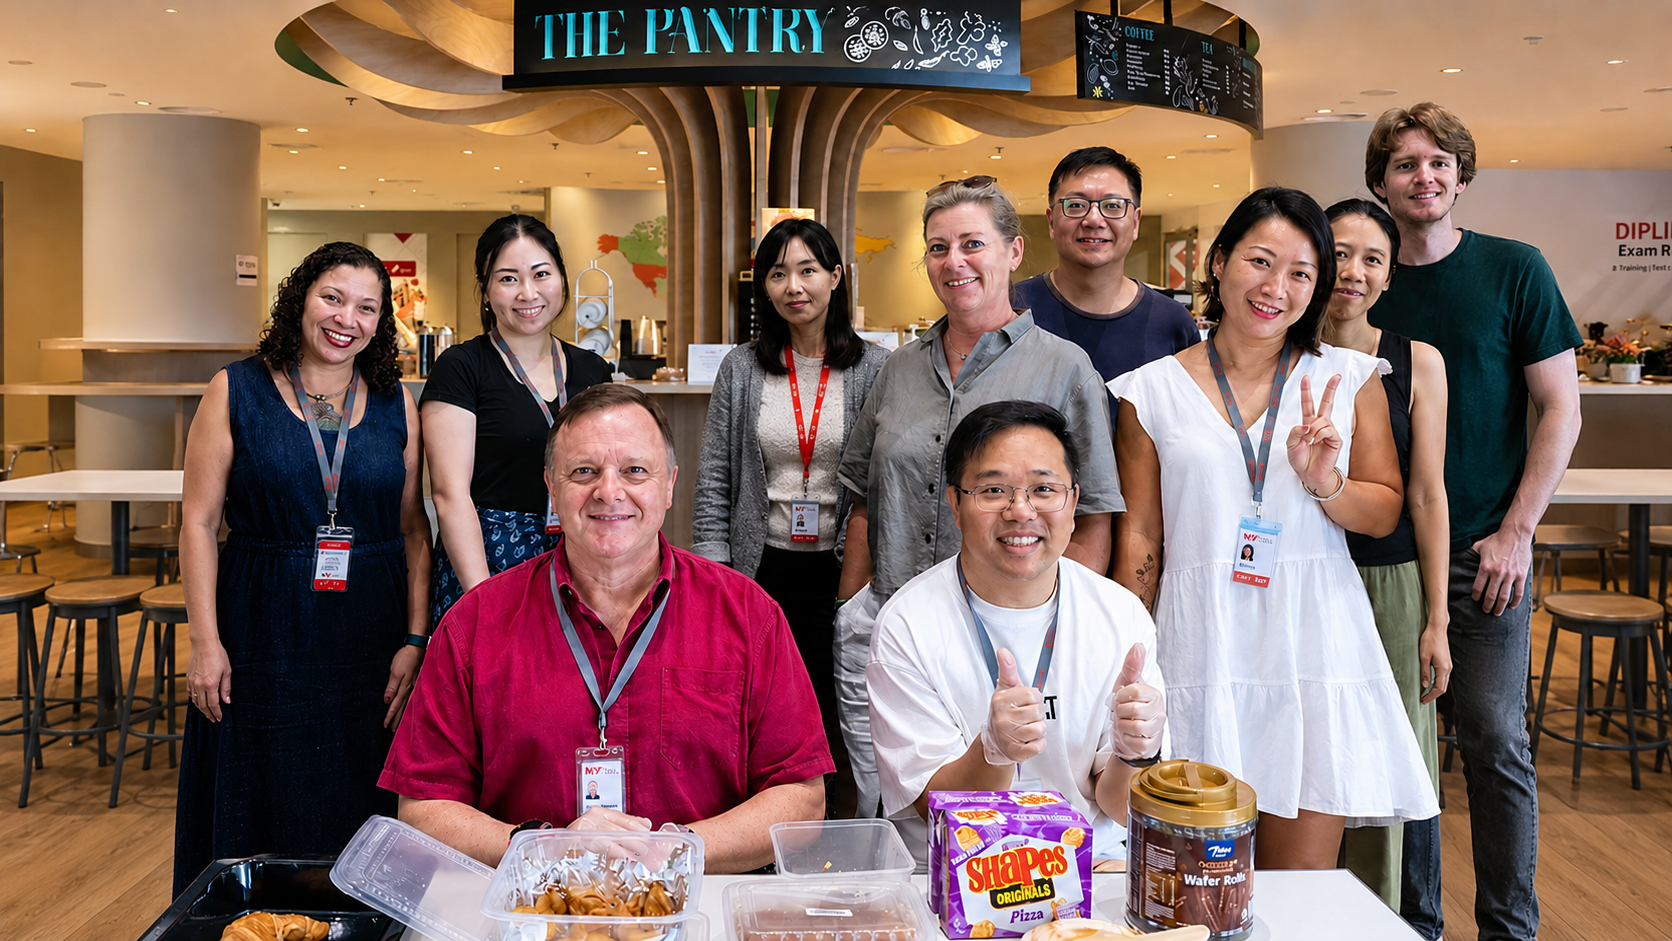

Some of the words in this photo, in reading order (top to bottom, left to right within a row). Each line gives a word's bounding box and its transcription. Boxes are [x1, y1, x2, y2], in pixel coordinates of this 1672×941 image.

[534, 10, 625, 60] THE
[644, 6, 836, 54] PANTRY
[1201, 41, 1214, 55] TEA
[1616, 222, 1672, 240] DIPLI
[1618, 244, 1658, 257] Exam
[1661, 244, 1672, 257] R
[1619, 264, 1648, 273] Training
[1652, 264, 1667, 272] Test
[1183, 873, 1221, 886] Wafer
[1223, 872, 1246, 886] Rolls
[996, 883, 1051, 905] ORIGINALS
[1009, 908, 1044, 924] Pizza
